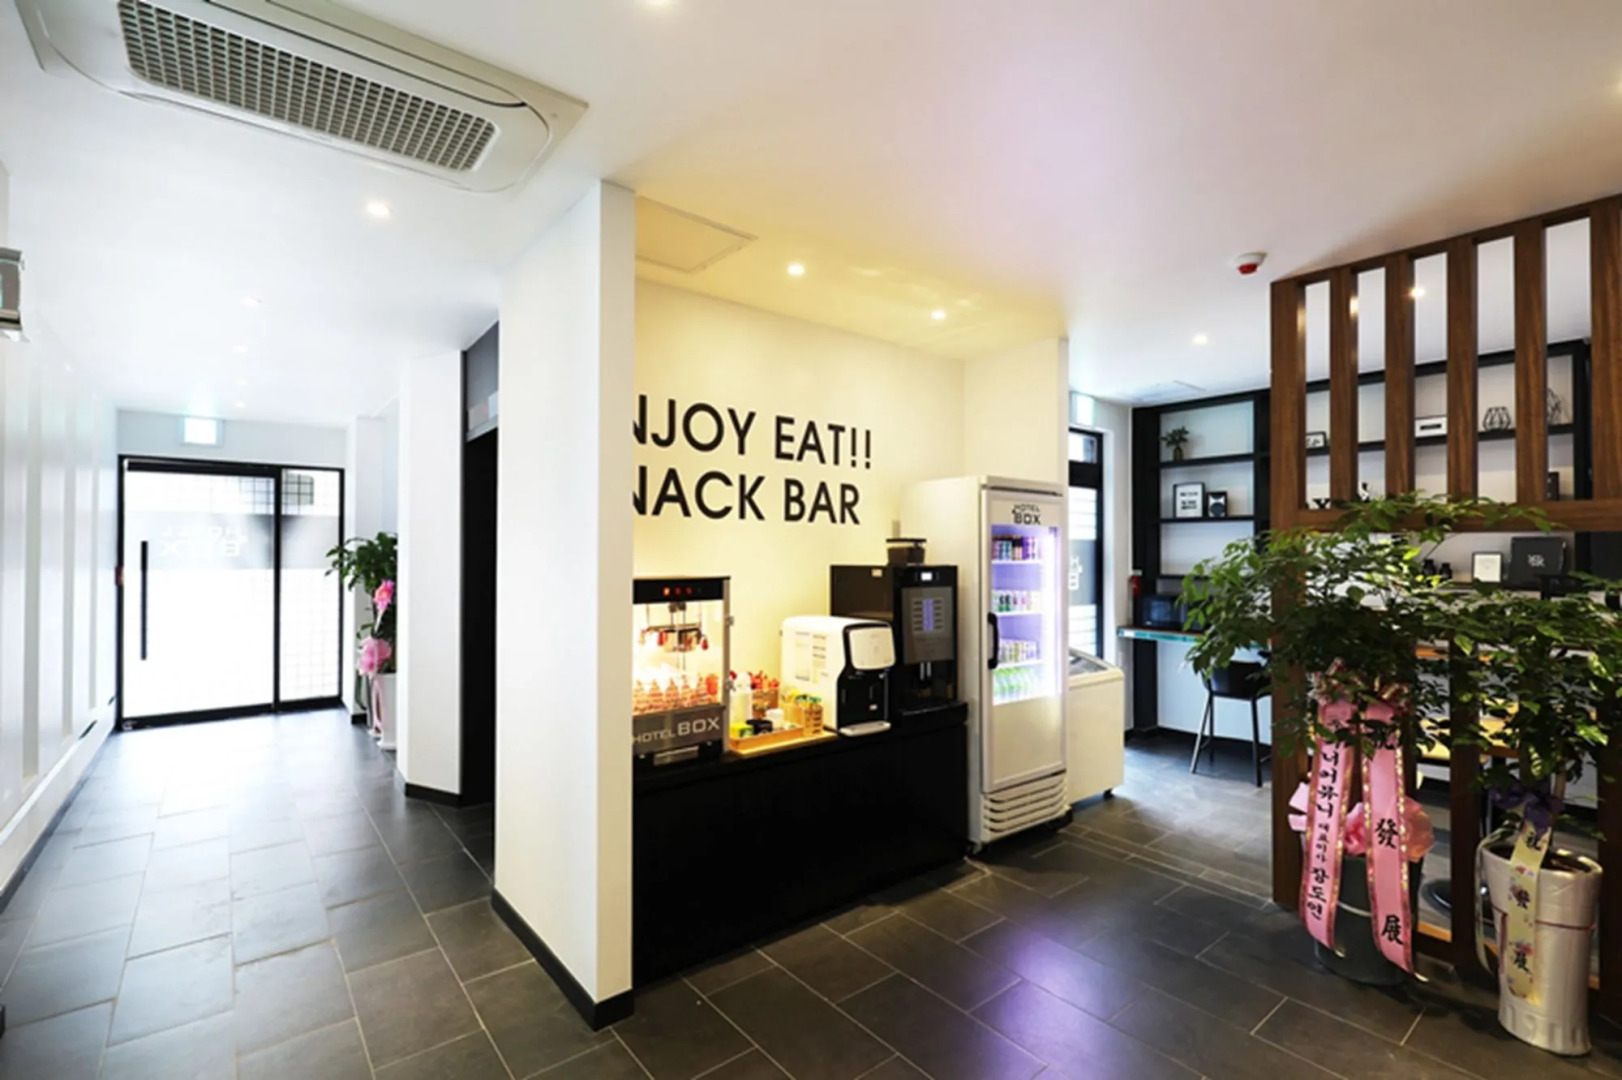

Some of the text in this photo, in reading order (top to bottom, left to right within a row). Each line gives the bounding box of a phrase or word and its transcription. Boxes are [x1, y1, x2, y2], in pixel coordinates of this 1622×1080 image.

[775, 415, 872, 469] EAT!!
[784, 478, 861, 525] BAR
[1013, 513, 1041, 525] BOX
[632, 716, 721, 743] HOTEL BOX
